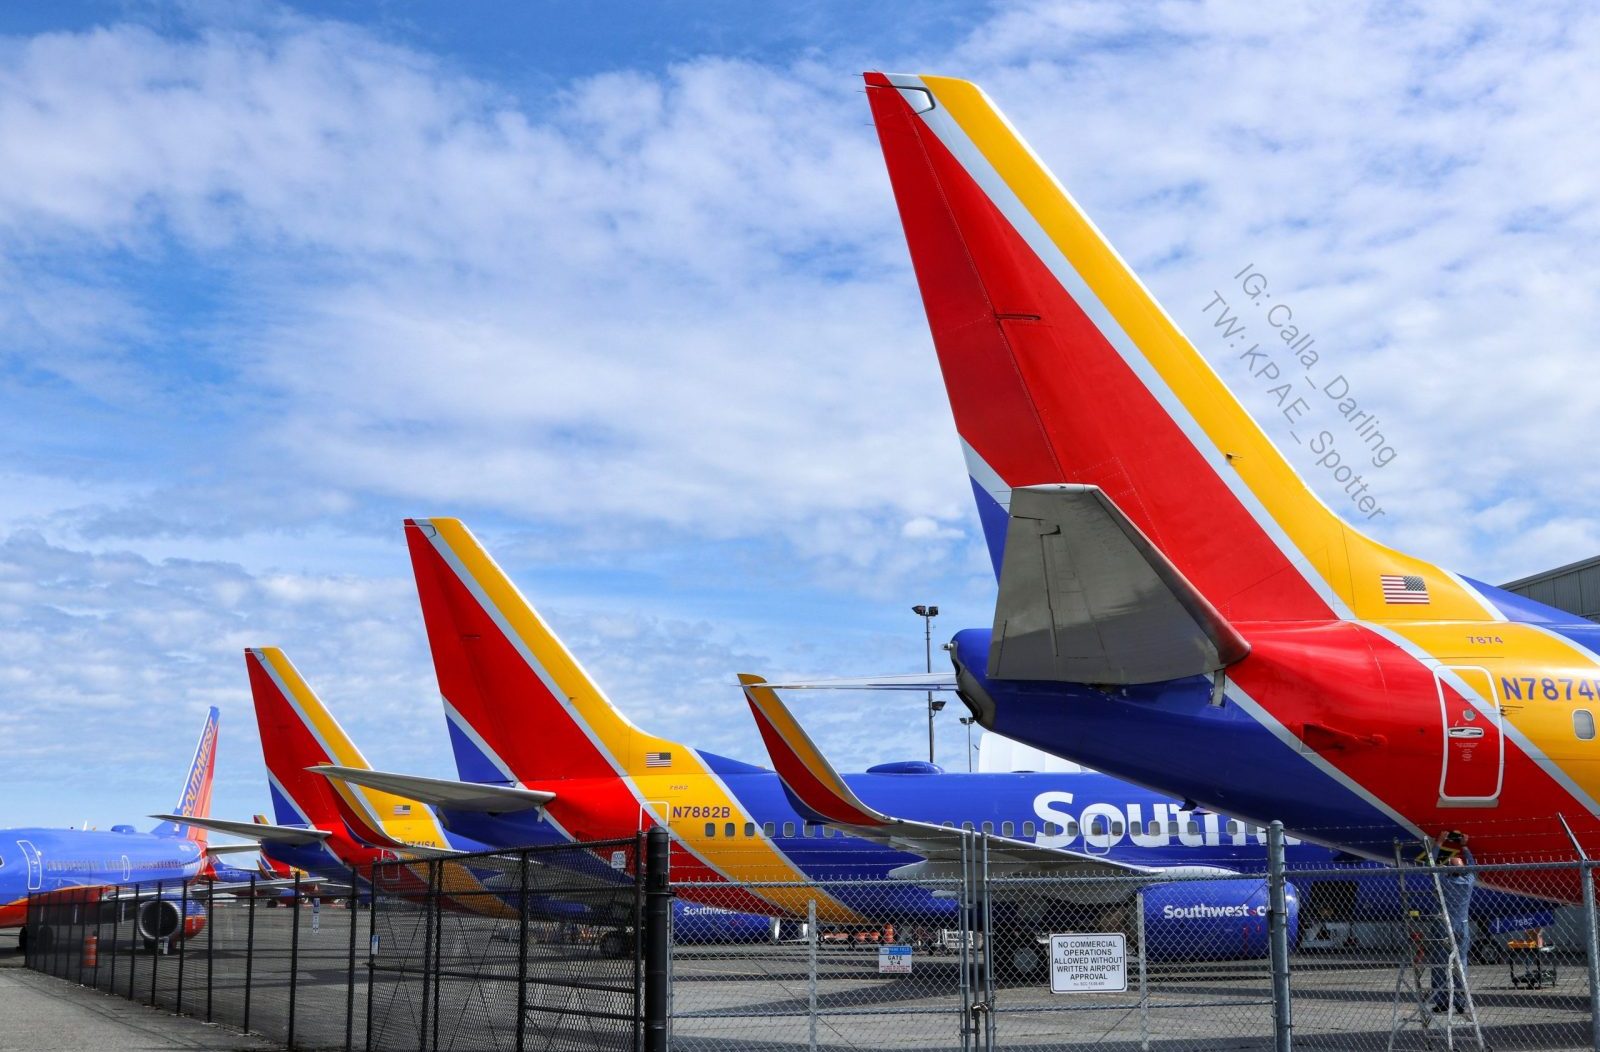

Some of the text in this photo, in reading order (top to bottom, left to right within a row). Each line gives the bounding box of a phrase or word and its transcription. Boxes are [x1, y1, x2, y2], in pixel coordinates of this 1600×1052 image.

[1466, 636, 1504, 644] 7874
[672, 806, 731, 819] N7882B
[1058, 940, 1118, 949] NO COMMERCIAL
[1063, 948, 1113, 956] OPERATIONS
[1091, 956, 1123, 964] WITHOUT
[1090, 964, 1121, 972] AIRPORT
